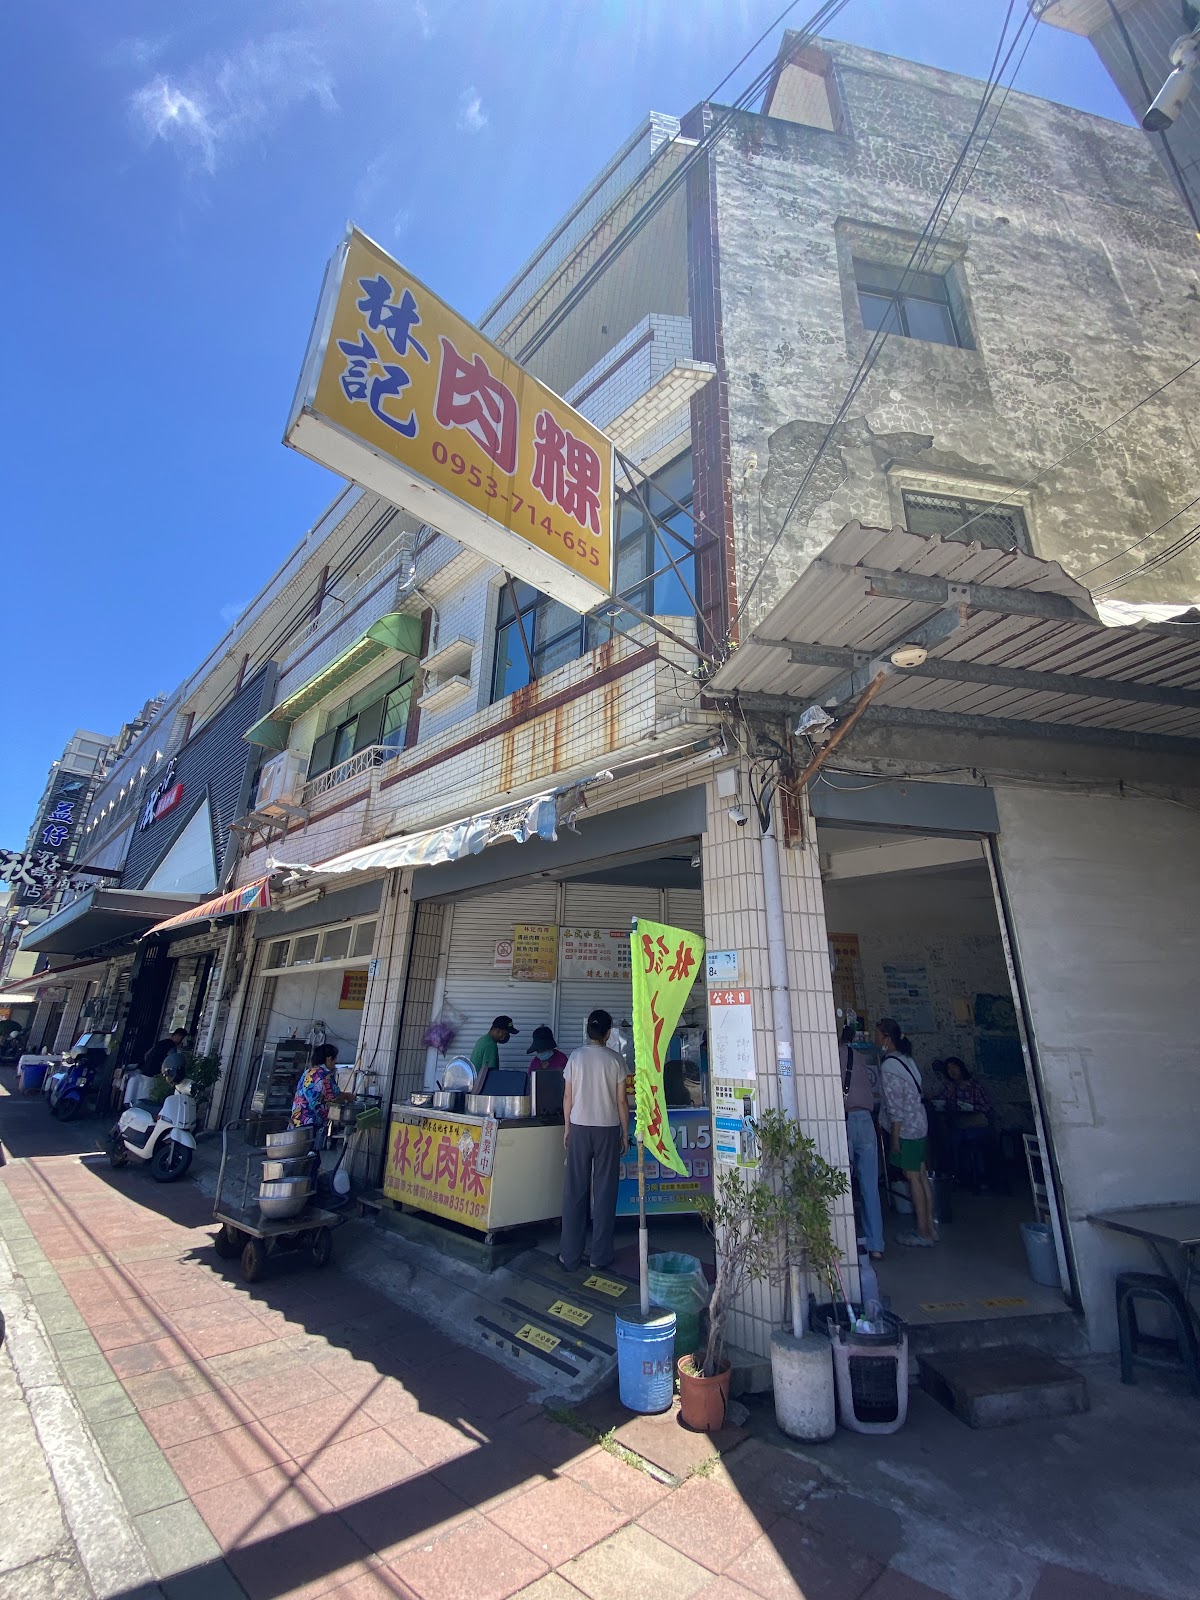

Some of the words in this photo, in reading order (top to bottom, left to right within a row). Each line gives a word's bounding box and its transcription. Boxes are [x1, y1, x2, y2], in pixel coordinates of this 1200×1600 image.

[338, 273, 429, 438] 林記
[431, 441, 600, 567] 0953-714-655
[433, 335, 602, 536] 肉粿
[712, 991, 746, 1005] 公休日
